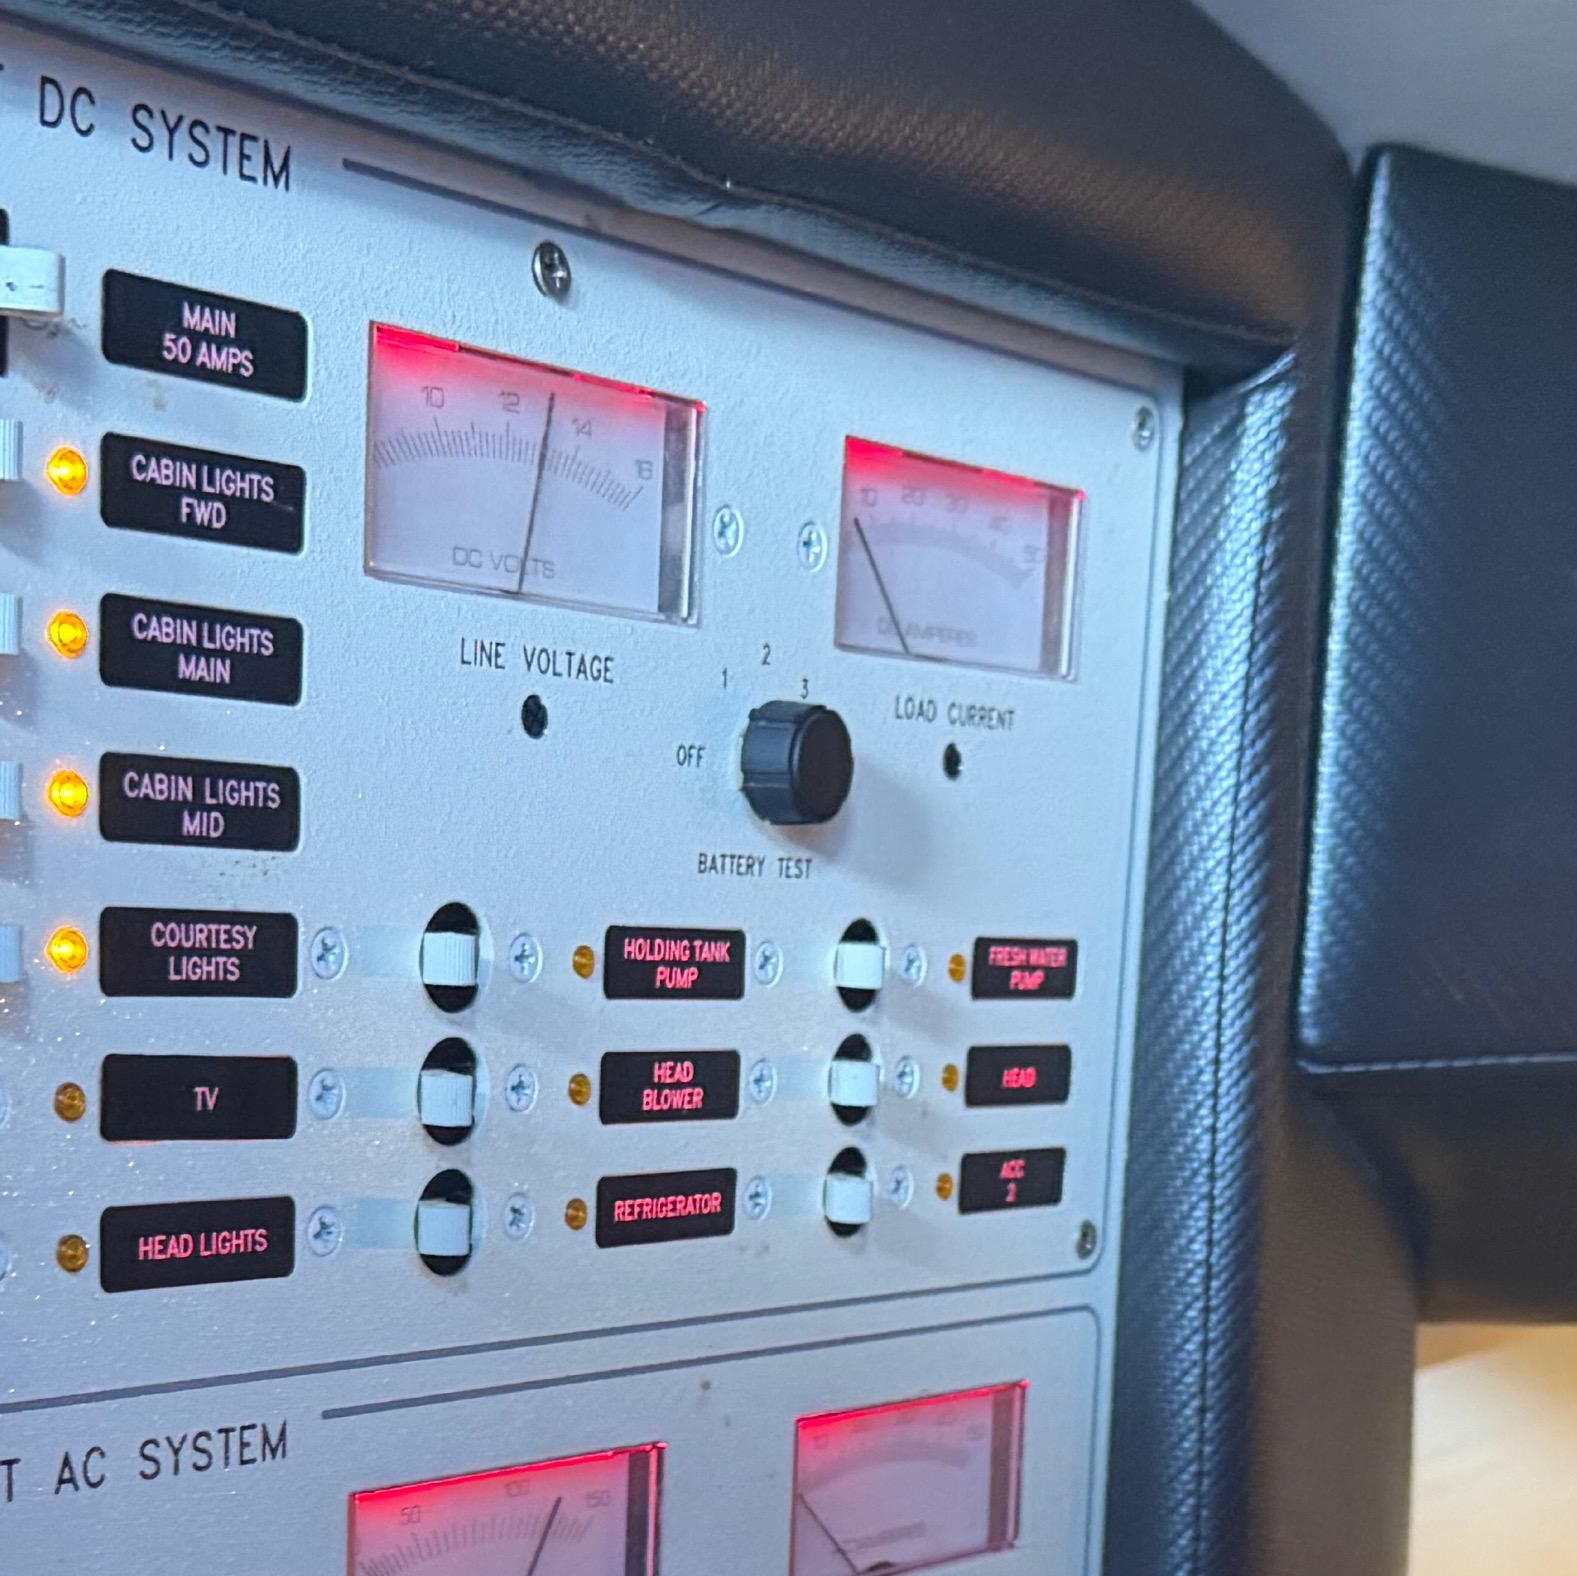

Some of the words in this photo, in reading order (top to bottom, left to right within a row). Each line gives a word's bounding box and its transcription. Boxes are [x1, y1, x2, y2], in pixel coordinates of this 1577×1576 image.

[39, 76, 96, 139] DC
[130, 103, 293, 193] SYSTEM
[183, 302, 237, 340] MAIN
[163, 333, 192, 364] 50
[196, 339, 254, 378] AMPS
[421, 386, 445, 408] 10
[499, 391, 520, 414] 12
[131, 454, 197, 492] CABIN
[202, 465, 275, 503] LIGHTS
[180, 499, 227, 530] FWD
[452, 546, 483, 568] DC
[132, 612, 199, 647] CABIN
[202, 619, 274, 655] LIGHTS
[460, 638, 506, 672] LINE
[523, 647, 615, 685] VOLTAGE
[761, 645, 771, 666] 2
[177, 653, 232, 686] MAIN
[722, 670, 728, 689] 1
[800, 679, 810, 699] 3
[895, 697, 937, 722] LOAD
[948, 703, 1015, 730] CURRENT
[676, 744, 706, 769] OFF
[124, 772, 194, 803] CABIN
[204, 778, 280, 809] LIGHTS
[182, 811, 225, 838] MID
[698, 853, 765, 877] BATTERY
[777, 857, 813, 880] TEST
[150, 922, 257, 952] COURTESY
[624, 937, 690, 964] HOLDING
[692, 941, 731, 964] TANK
[168, 955, 241, 982] LIGHTS
[655, 966, 699, 989] PUMP
[1009, 970, 1045, 990] PUMP
[653, 1061, 695, 1086] HEAD
[1002, 1067, 1038, 1088] HEAD
[193, 1087, 218, 1111] TV
[642, 1087, 704, 1112] BLOWER
[614, 1191, 722, 1224] REFRIGERATOR
[138, 1232, 193, 1261] HEAD
[199, 1229, 268, 1258] LIGHTS
[54, 1447, 106, 1495] AC
[138, 1420, 288, 1481] SYSTEM
[400, 1505, 421, 1525] 50
